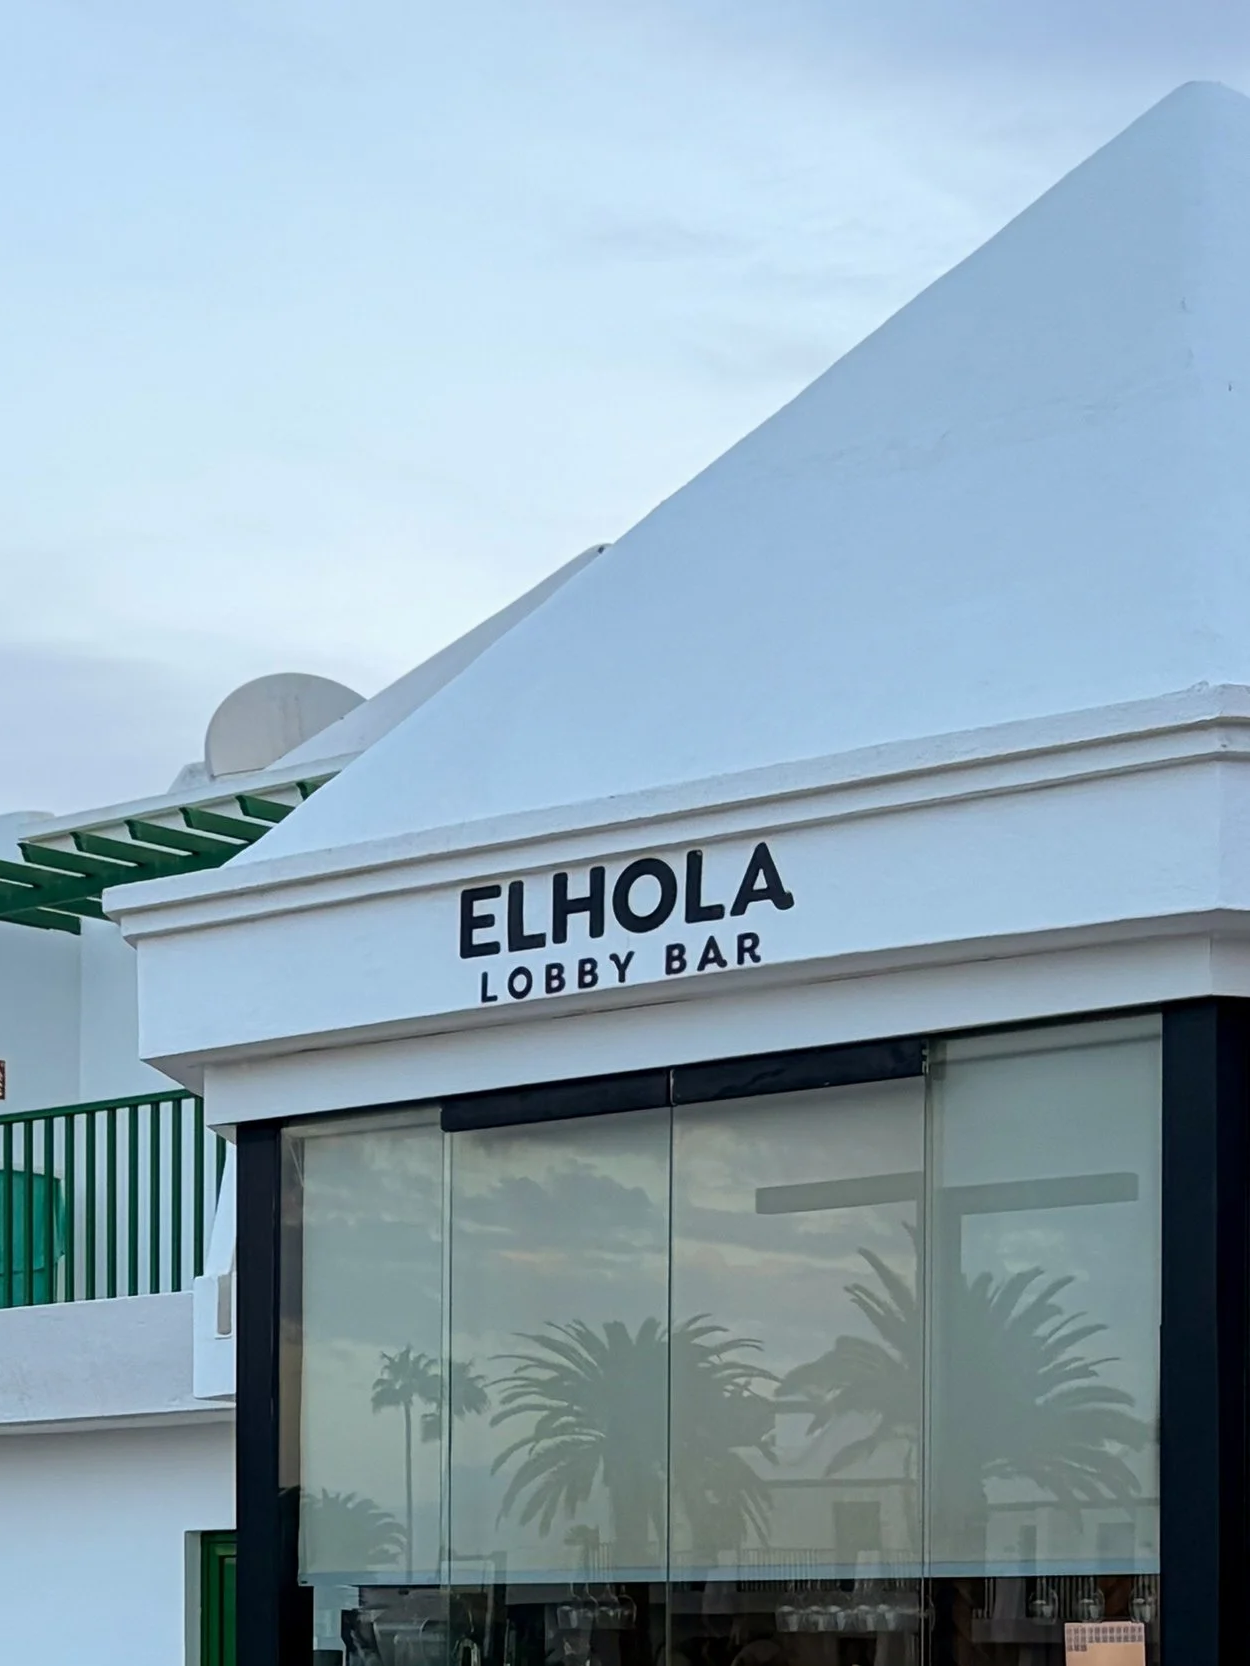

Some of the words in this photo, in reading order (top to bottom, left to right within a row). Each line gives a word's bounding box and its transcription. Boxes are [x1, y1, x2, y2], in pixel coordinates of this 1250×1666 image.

[459, 842, 795, 959] ELHOLA
[481, 951, 635, 1002] LOBBY
[665, 932, 762, 975] BAR
